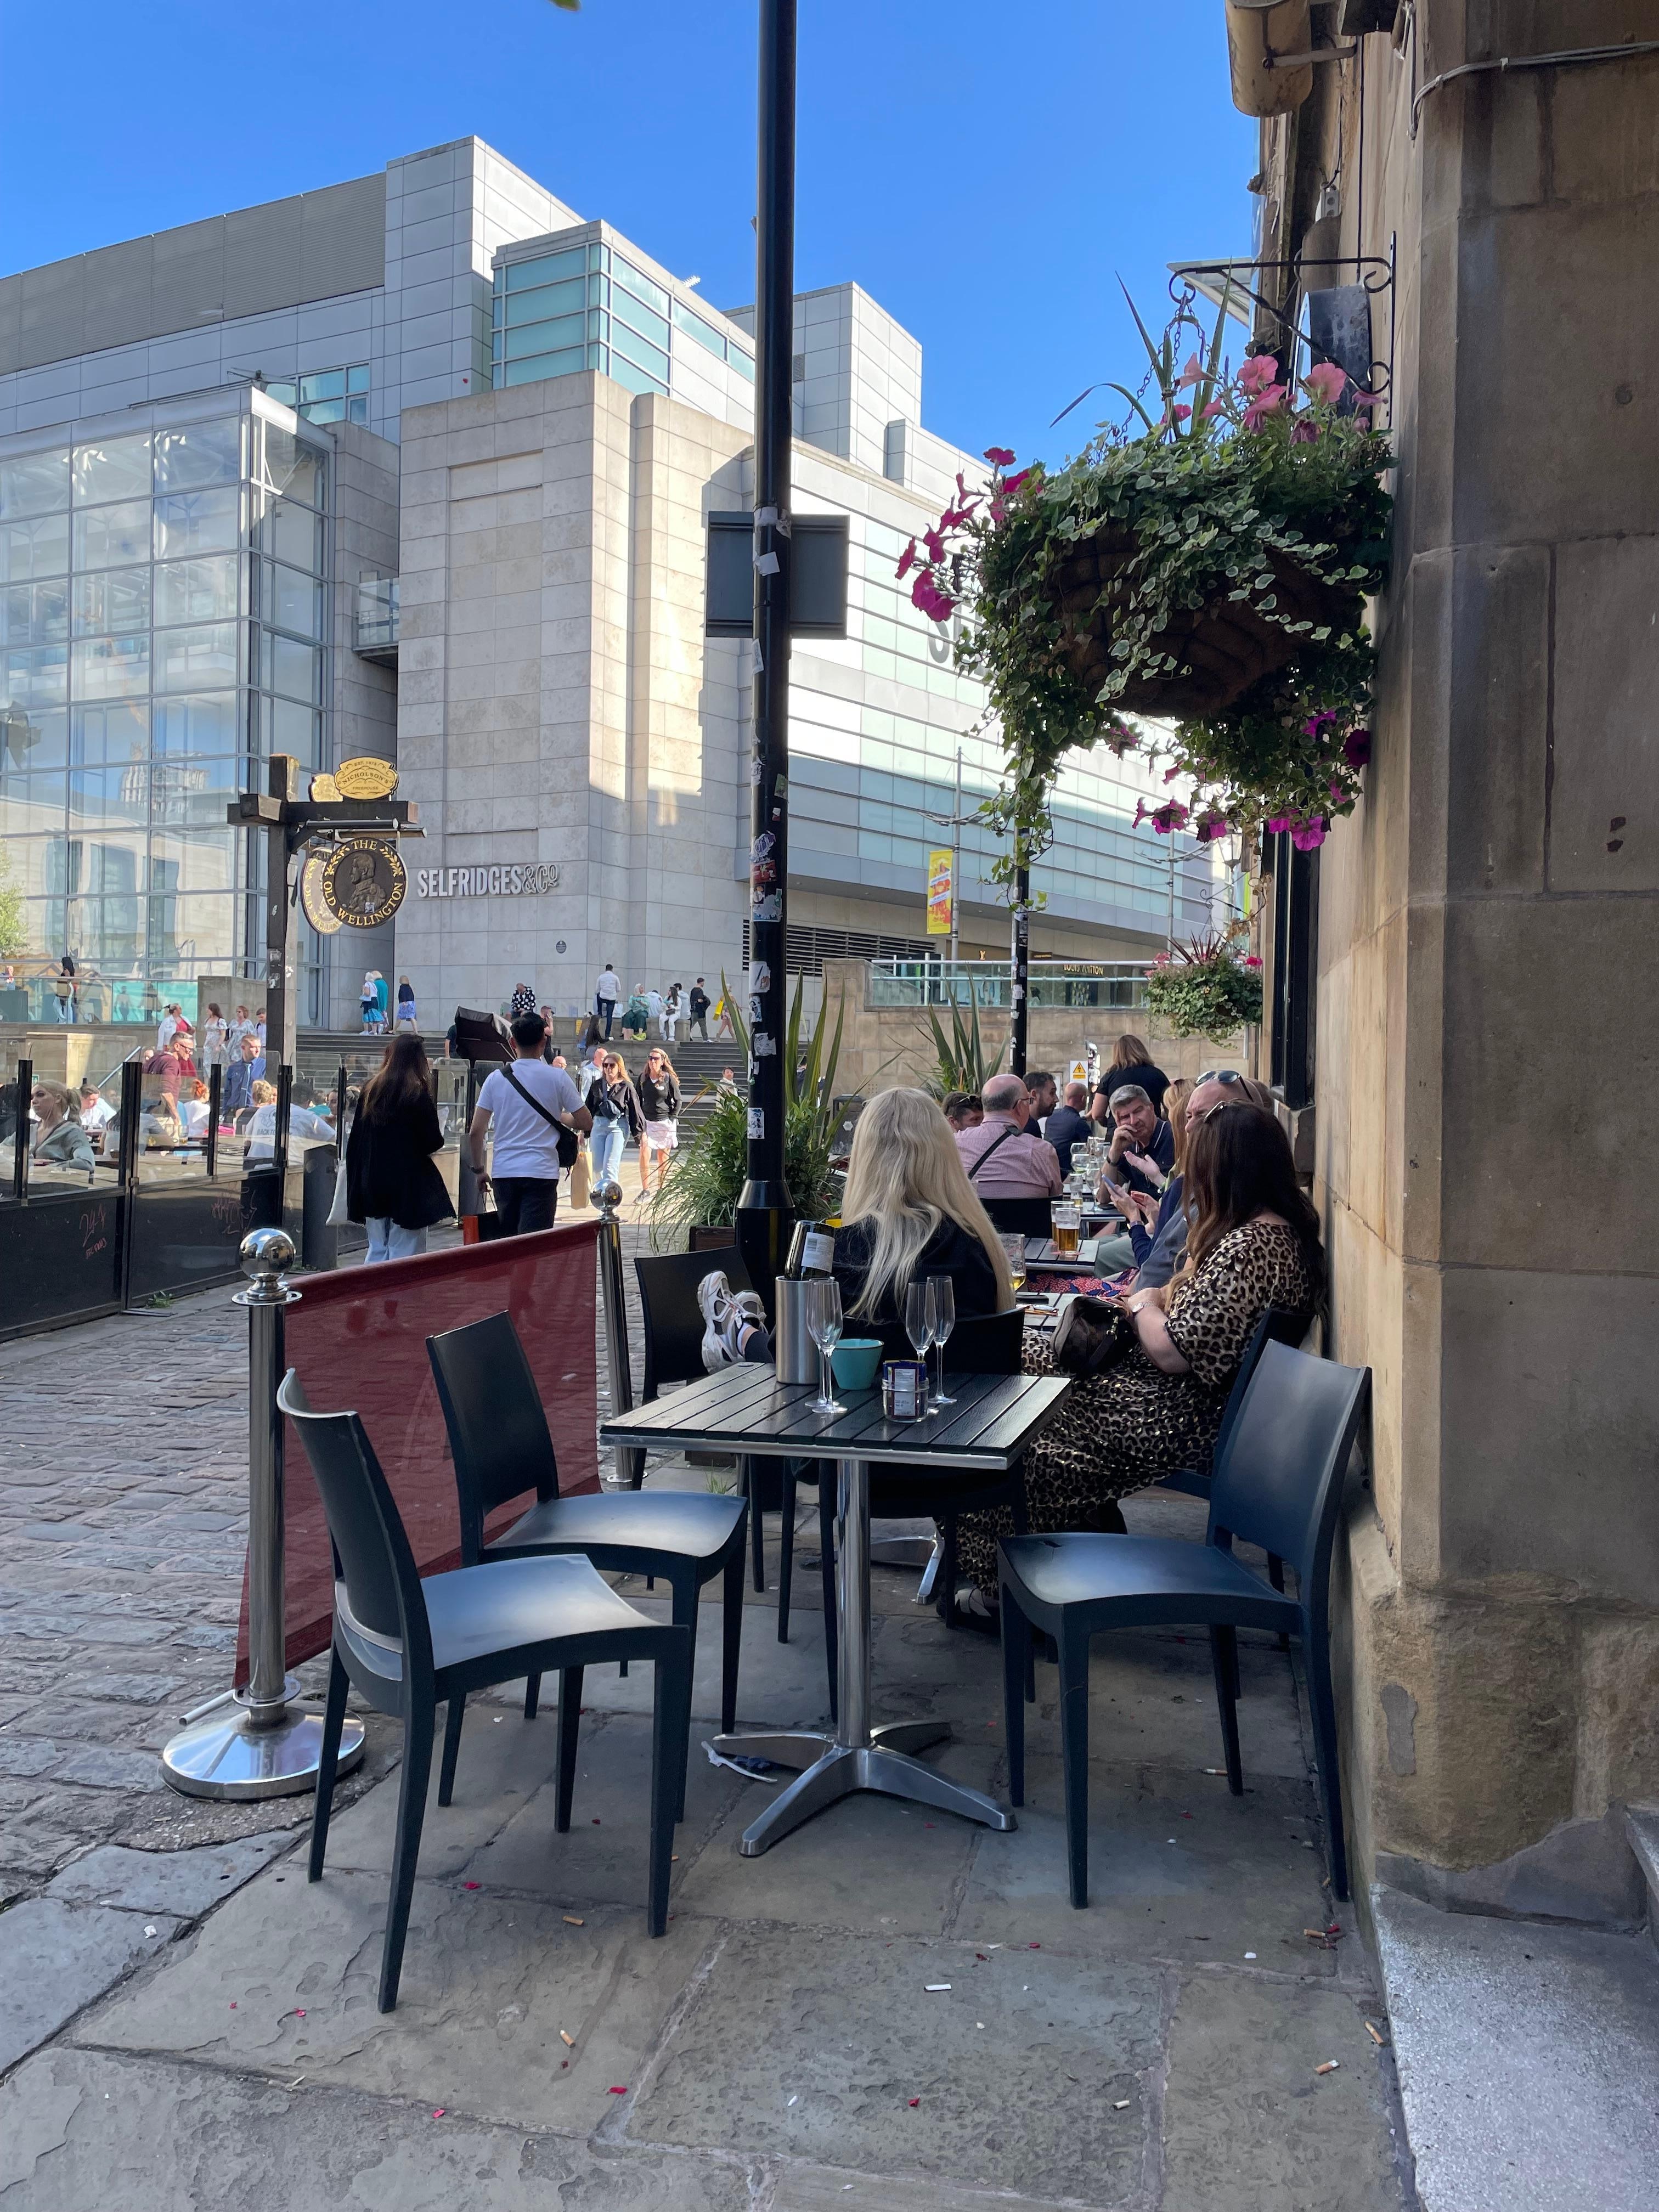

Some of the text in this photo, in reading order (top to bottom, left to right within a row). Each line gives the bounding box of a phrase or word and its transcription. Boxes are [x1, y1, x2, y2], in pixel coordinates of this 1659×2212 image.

[342, 772, 389, 785] NICHOLSON'S
[351, 839, 378, 850] THE
[323, 881, 404, 926] OLD WELLINGTON
[1063, 964, 1104, 975] LOUIS VUITTON
